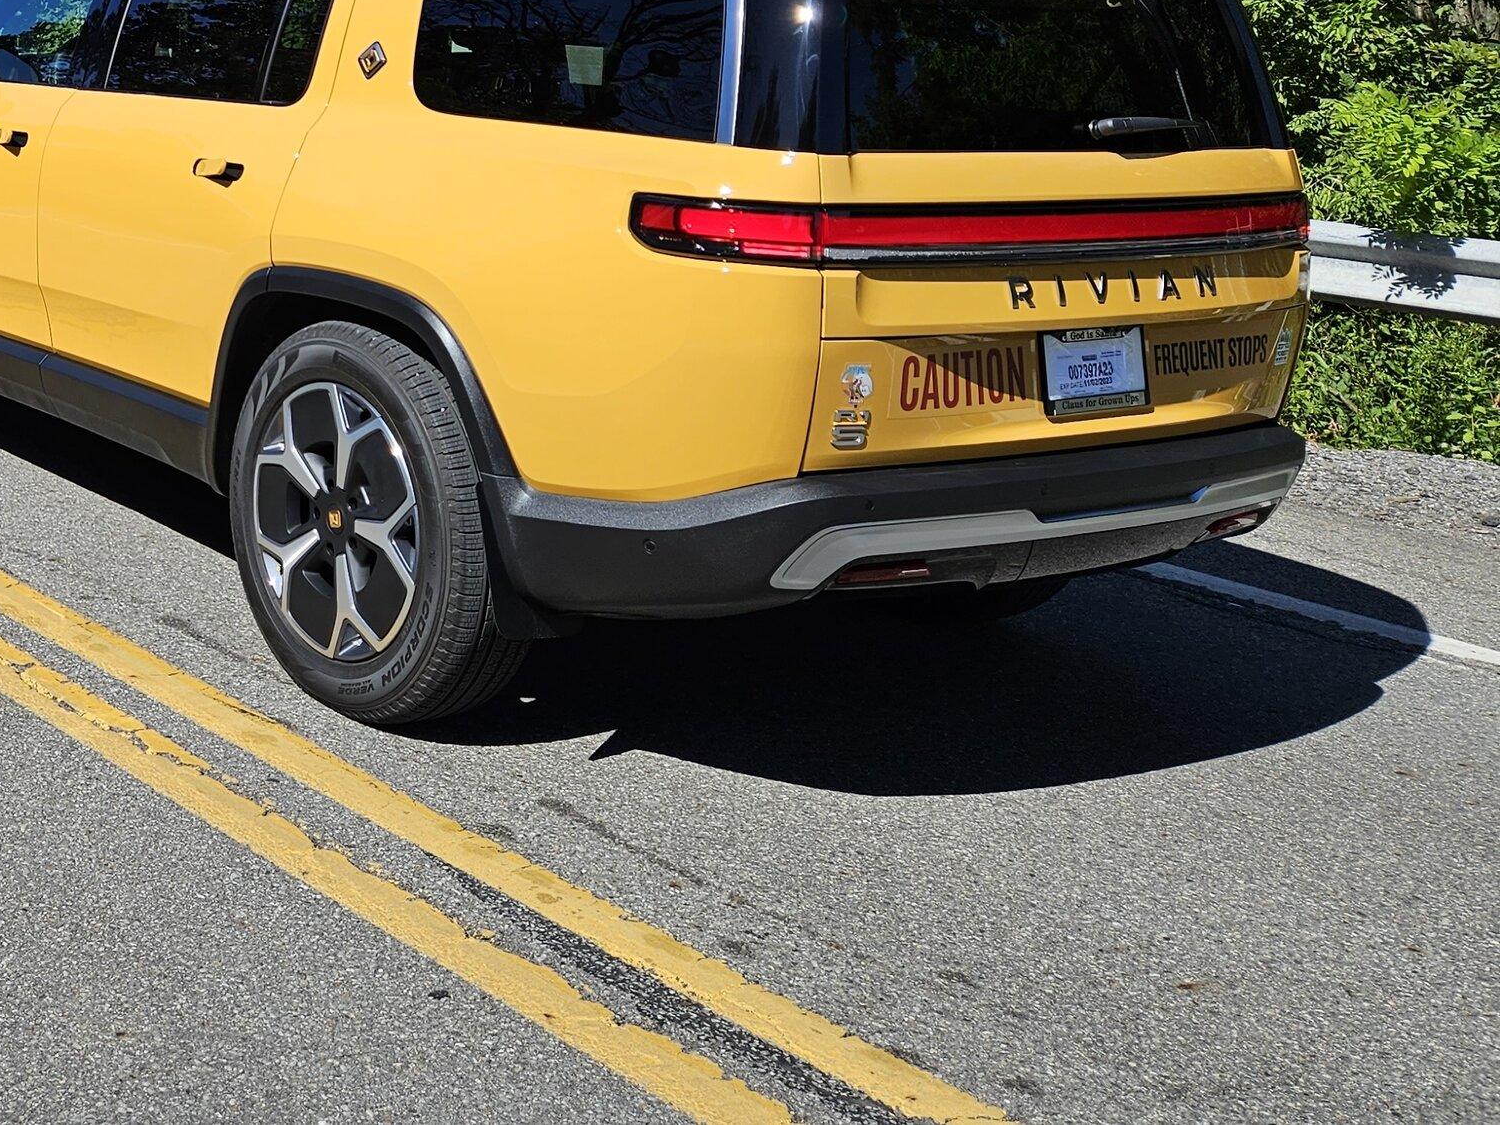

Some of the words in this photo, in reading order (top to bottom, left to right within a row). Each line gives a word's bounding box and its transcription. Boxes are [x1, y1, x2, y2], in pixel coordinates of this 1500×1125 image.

[1007, 265, 1217, 309] RIVIAN
[1070, 331, 1085, 340] God
[1086, 331, 1094, 339] is
[1154, 339, 1225, 377] FREQUENT
[1228, 334, 1268, 367] STOPS
[900, 346, 1026, 411] CAUTION
[1062, 399, 1083, 409] Claus
[1086, 397, 1096, 407] for
[1098, 395, 1124, 406] Grown
[1126, 393, 1140, 405] Ups
[380, 582, 434, 687] SCORPION
[338, 684, 374, 695] VERDE
